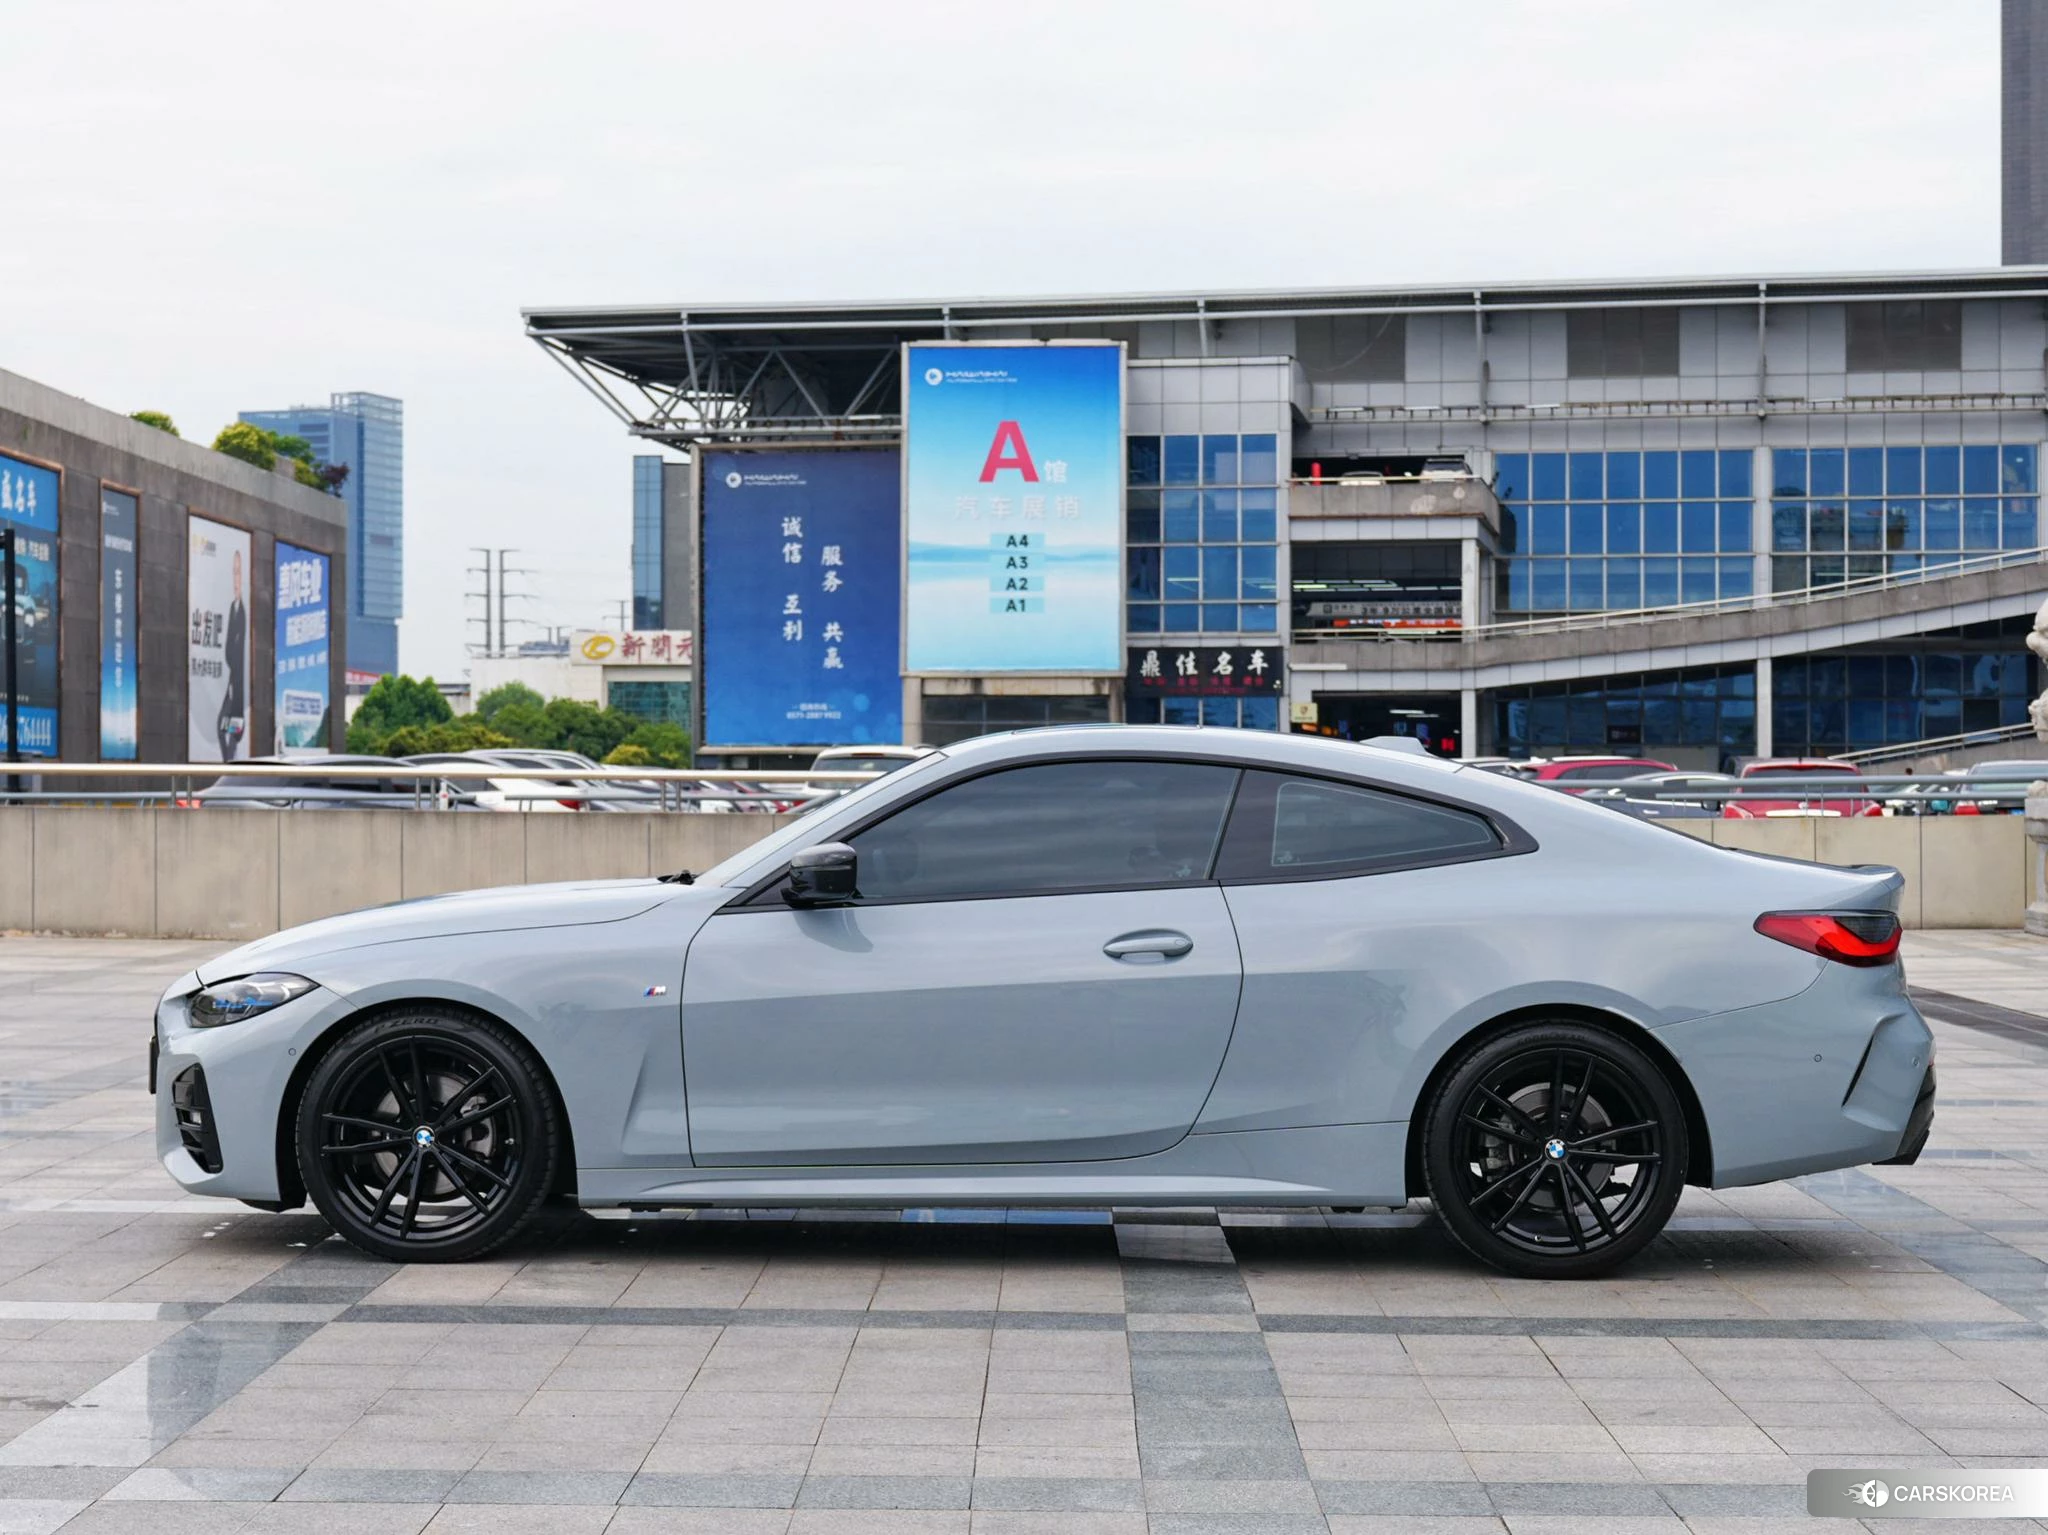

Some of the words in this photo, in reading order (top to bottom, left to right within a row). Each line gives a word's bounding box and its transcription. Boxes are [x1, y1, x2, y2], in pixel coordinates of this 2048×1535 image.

[955, 496, 1081, 519] 汽车展销
[1006, 535, 1029, 547] A4
[1006, 556, 1029, 569] A3
[1006, 578, 1029, 591] A2
[1006, 600, 1027, 612] A1
[391, 1017, 440, 1027] ZERO
